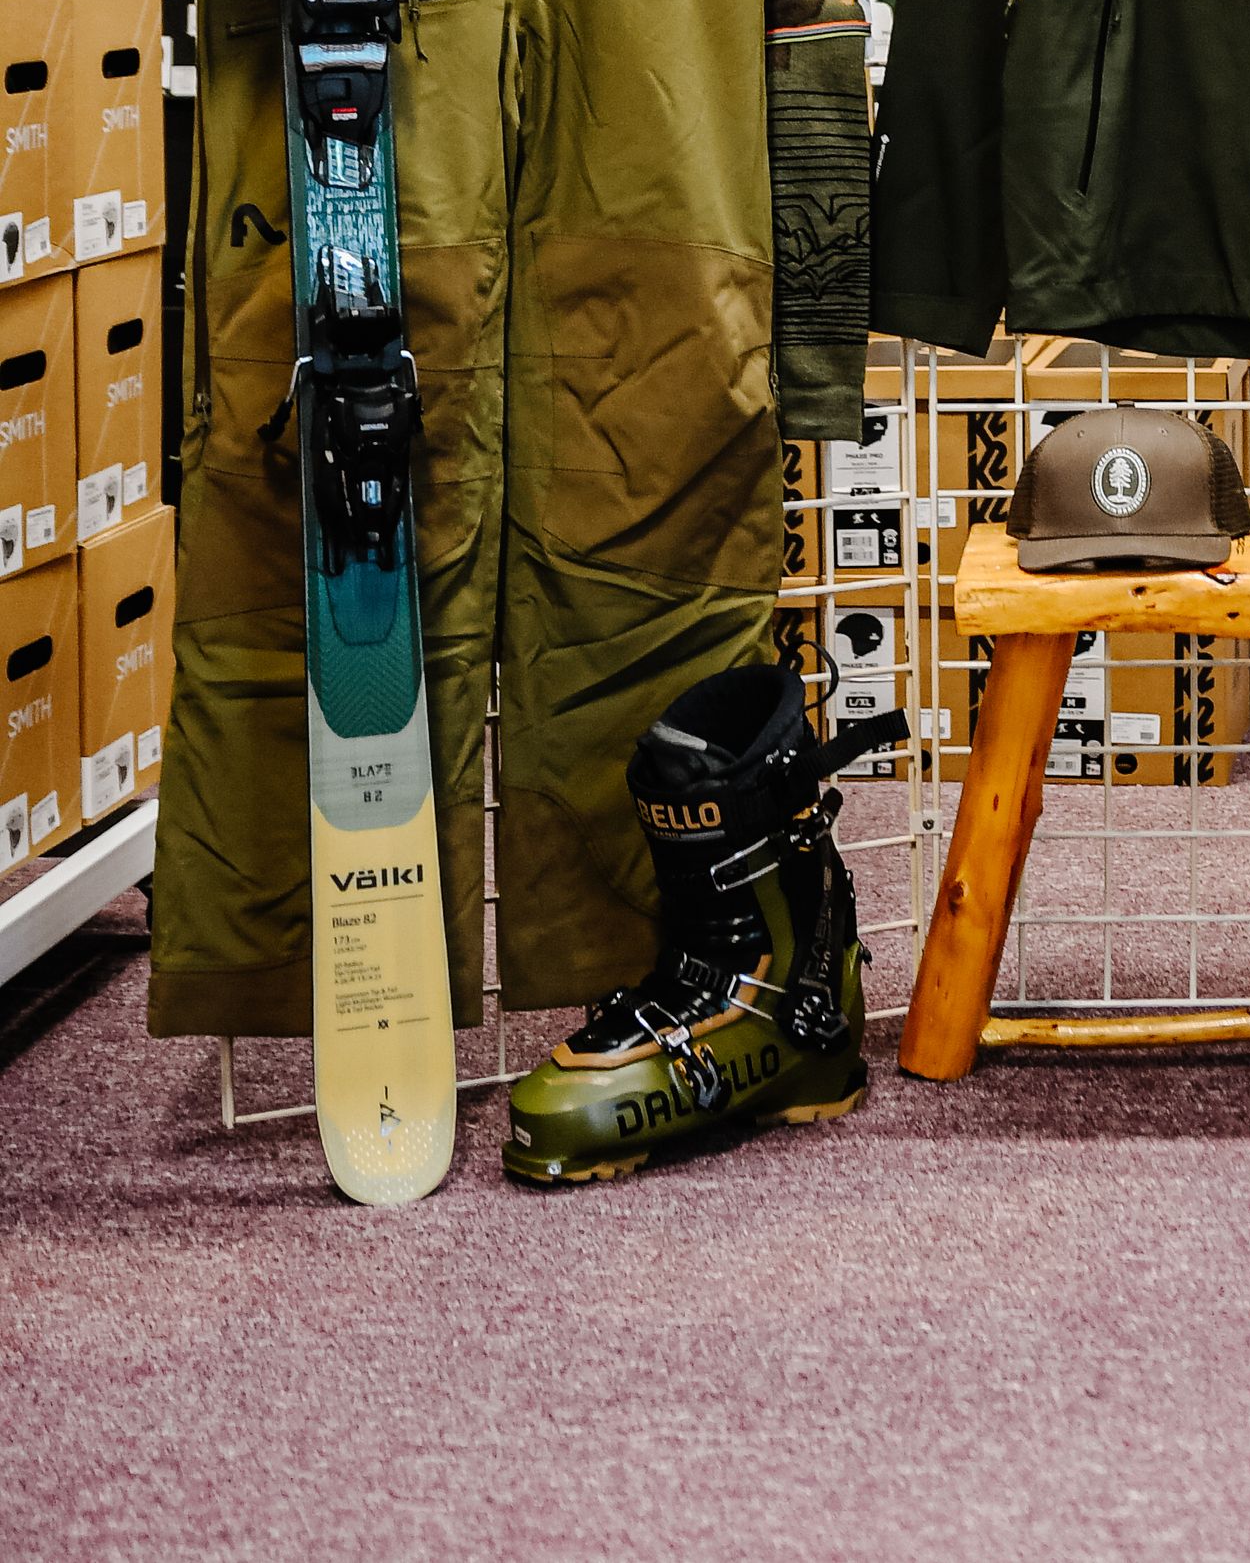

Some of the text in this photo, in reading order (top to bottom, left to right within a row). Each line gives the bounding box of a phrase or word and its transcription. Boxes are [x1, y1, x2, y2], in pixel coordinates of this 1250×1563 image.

[102, 104, 140, 133] SMITH
[6, 123, 48, 155] SMITH
[107, 374, 144, 408] SMITH
[115, 639, 155, 681] SMITH
[7, 693, 53, 739] SMITH
[637, 798, 722, 830] BELLO
[330, 864, 424, 892] Völkl
[332, 913, 377, 929] Blaze 82
